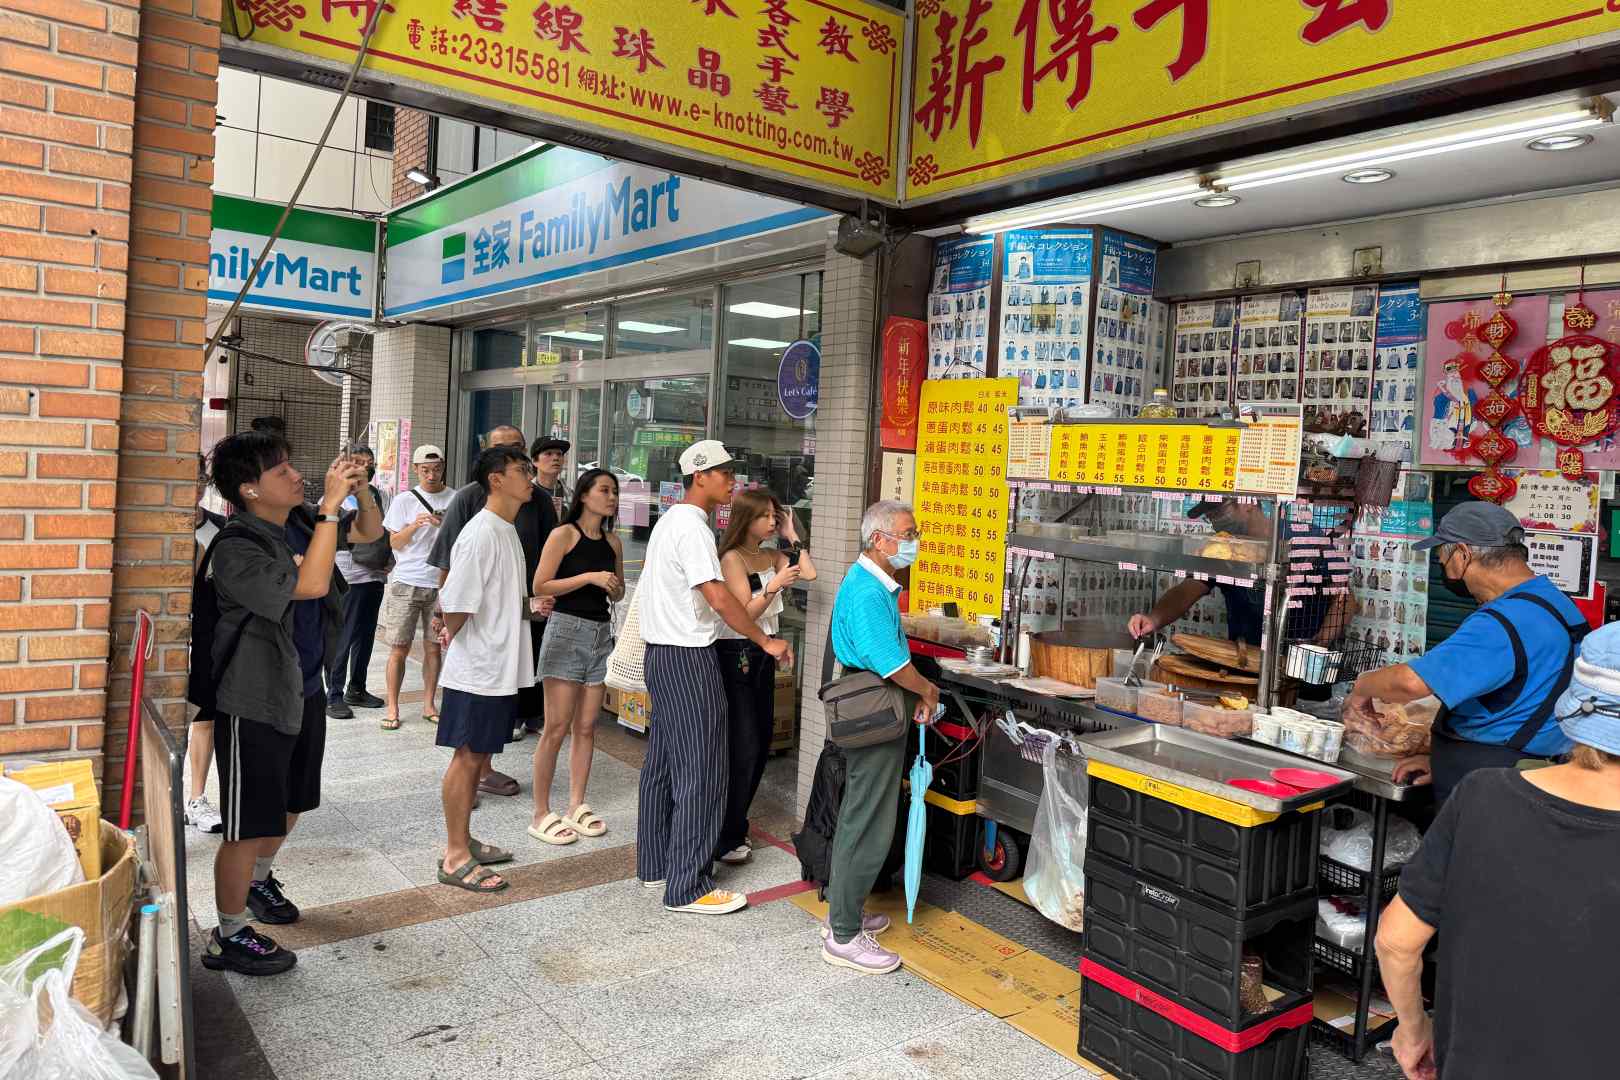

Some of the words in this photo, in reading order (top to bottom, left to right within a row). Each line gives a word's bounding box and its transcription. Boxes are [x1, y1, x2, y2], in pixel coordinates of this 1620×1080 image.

[472, 215, 512, 276] 全家
[518, 174, 681, 256] FamilyMart
[1541, 344, 1613, 410] 福
